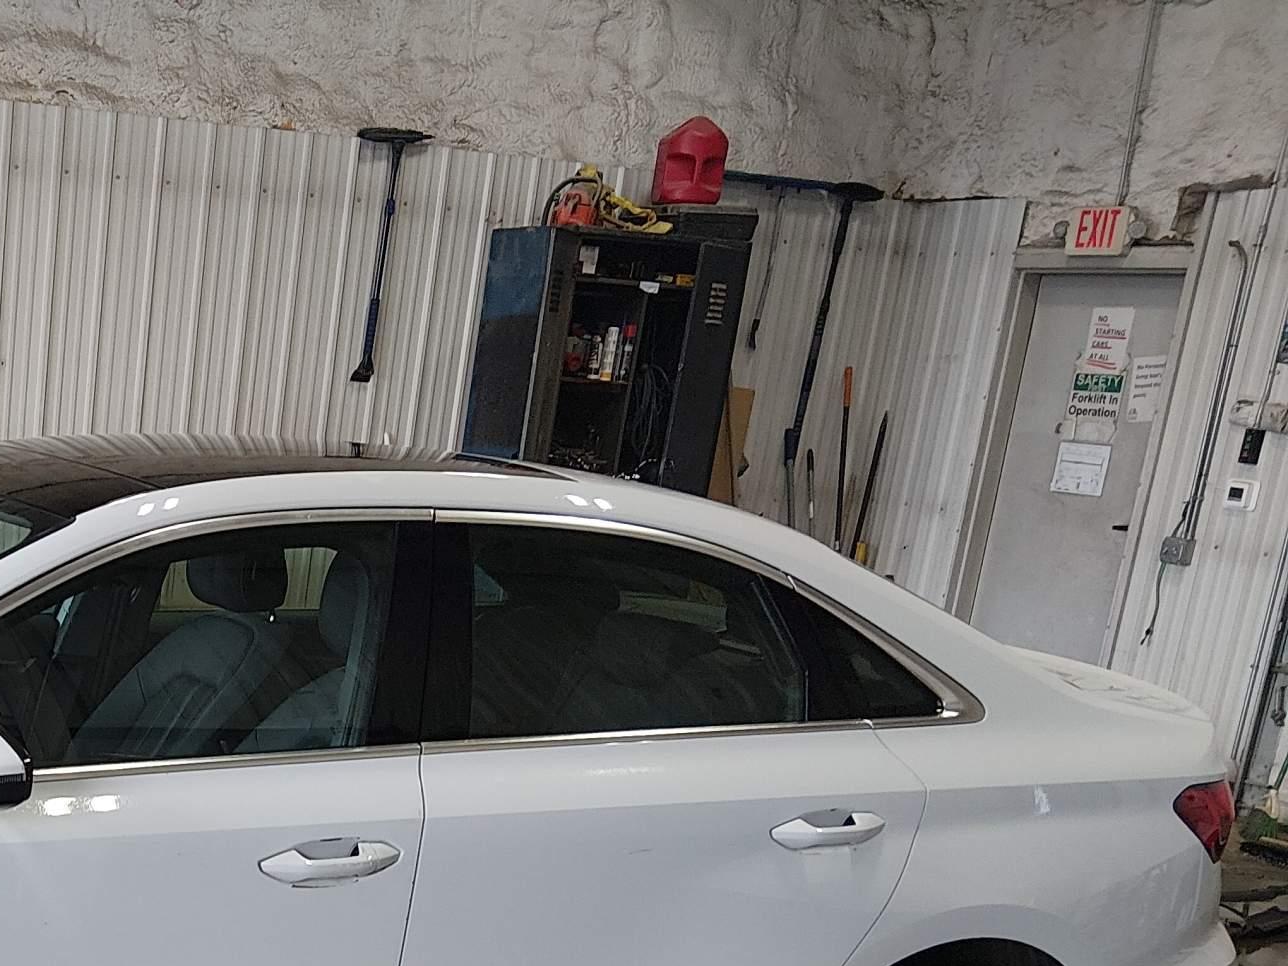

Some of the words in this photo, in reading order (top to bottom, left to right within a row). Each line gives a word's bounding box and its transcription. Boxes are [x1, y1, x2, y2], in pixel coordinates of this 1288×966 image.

[1075, 209, 1121, 248] EXIT
[1095, 328, 1126, 336] STARTING
[1076, 374, 1121, 387] SAFETY
[1072, 392, 1106, 404] Forklift
[1068, 404, 1116, 418] Operation
